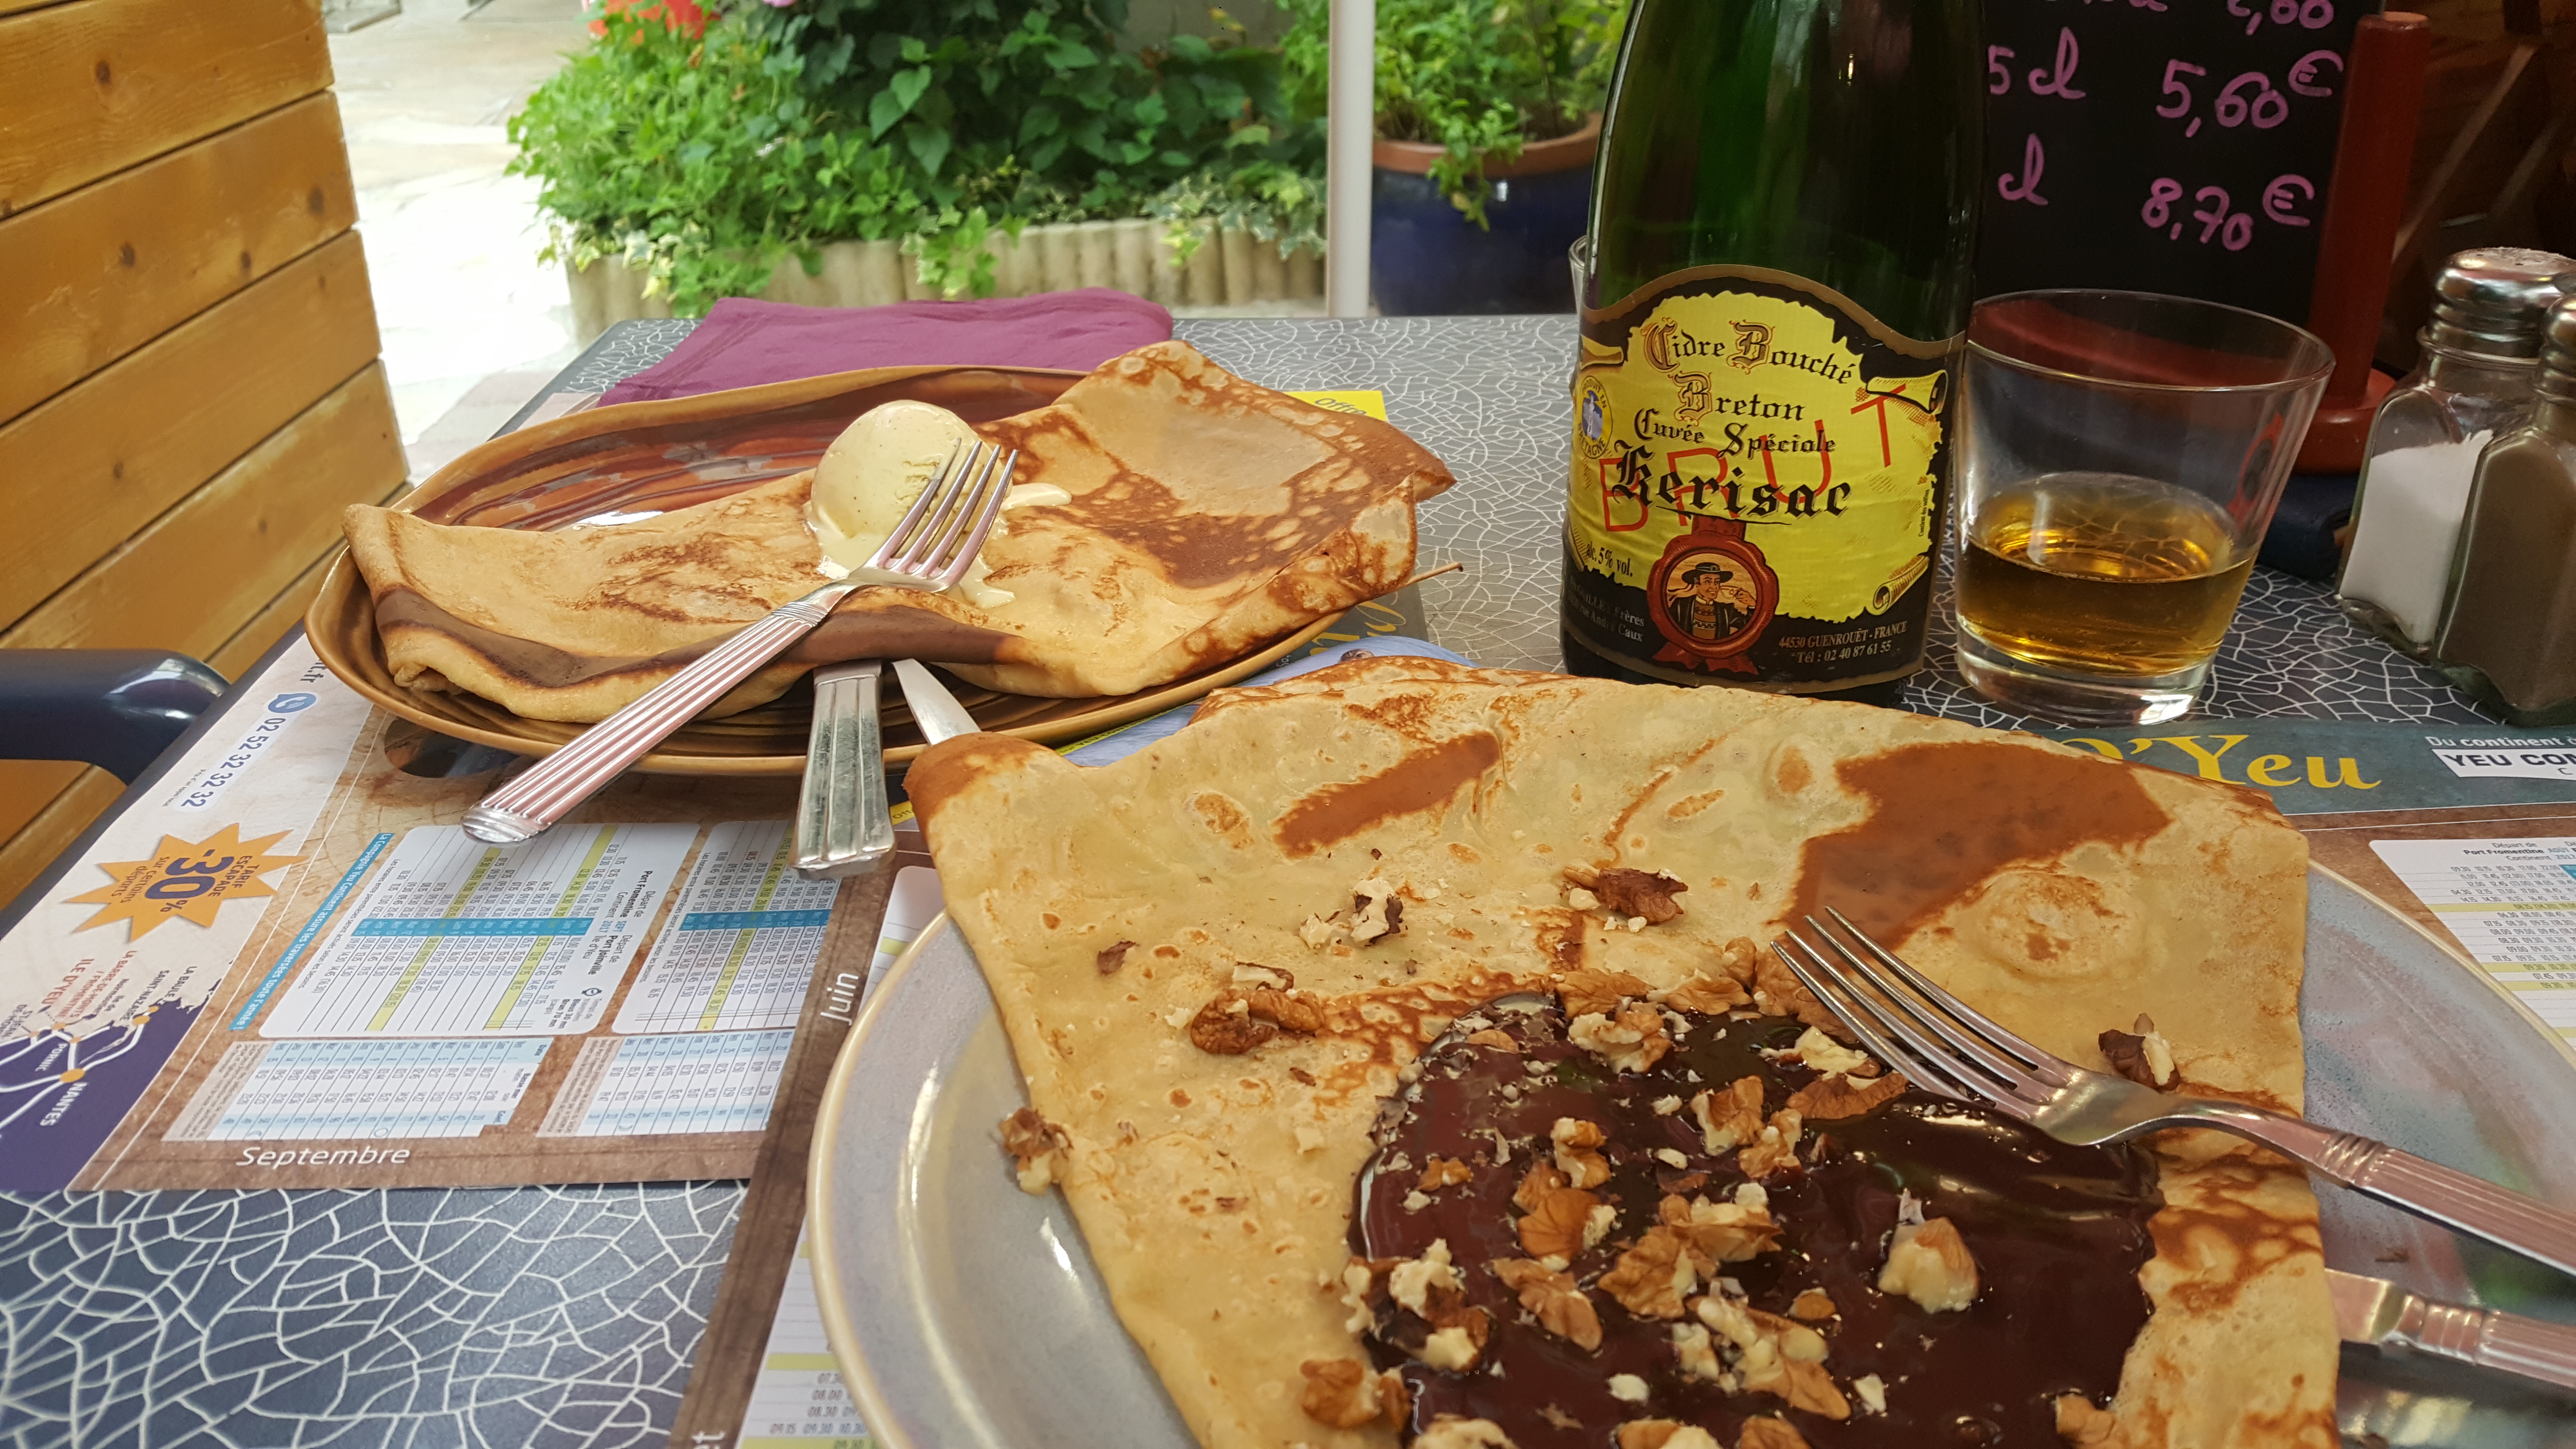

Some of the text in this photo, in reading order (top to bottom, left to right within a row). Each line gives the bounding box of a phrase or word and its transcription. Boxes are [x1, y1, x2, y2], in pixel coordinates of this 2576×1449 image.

[1642, 318, 1856, 385] Cidre Bouché
[1668, 371, 1806, 426] Breton
[1634, 408, 1836, 459] Cuvée Spéciale
[1600, 384, 1907, 532] BRUT
[1611, 440, 1852, 520] Kerisac
[1598, 547, 1613, 568] 5%
[1617, 558, 1633, 577] vol.
[1614, 607, 1644, 627] Frères
[1618, 624, 1643, 643] Caux
[1779, 637, 1805, 648] 44530
[1874, 621, 1907, 639] FRANCE
[1797, 651, 1814, 663] Tél
[1824, 650, 1836, 661] 02
[1839, 647, 1851, 659] 40
[1853, 645, 1865, 657] 87
[1867, 643, 1877, 655] 61
[1880, 640, 1892, 653] 55
[2425, 736, 2457, 747] Du
[2460, 737, 2565, 747] continent
[180, 718, 286, 807] 02 52 32 32 32
[2442, 754, 2513, 767] YEU
[354, 840, 385, 869] Compagnie
[693, 860, 707, 875] horaires
[111, 866, 147, 897] départs
[121, 857, 170, 903] sur certains
[208, 856, 253, 897] ESCAPADE
[232, 864, 259, 888] TARIF
[346, 871, 362, 881] Yeu
[378, 867, 395, 882] horaires
[688, 876, 697, 886] entre
[322, 882, 352, 910] Continent
[370, 883, 381, 893] entre
[612, 870, 653, 932] Port Fromentine SEPT
[637, 891, 656, 909] Départ
[675, 888, 692, 913] parenthèses
[350, 894, 372, 918] parenthèses
[599, 892, 628, 933] Continent 2017
[306, 912, 331, 931] assure
[339, 919, 353, 933] seront
[668, 914, 679, 927] seront
[299, 933, 314, 942] les
[613, 935, 632, 954] Départ
[272, 943, 310, 978] traversées
[582, 944, 598, 958] d'Yeu
[588, 935, 618, 974] Port Joinville
[41, 958, 94, 1005] ILE D'YEU
[70, 950, 137, 1018] LA BARRE-DE-MONTS
[165, 976, 190, 998] BAULE
[257, 979, 278, 998] toute
[56, 974, 101, 1018] FROMENTINE
[120, 970, 170, 1021] SAINT-NAZAIRE
[558, 998, 570, 1010] Brun
[820, 973, 859, 1026] Juin
[236, 999, 264, 1025] l'année
[35, 1043, 67, 1072] PORNIC
[39, 1081, 88, 1126] NANTES
[236, 1147, 410, 1170] Septembre
